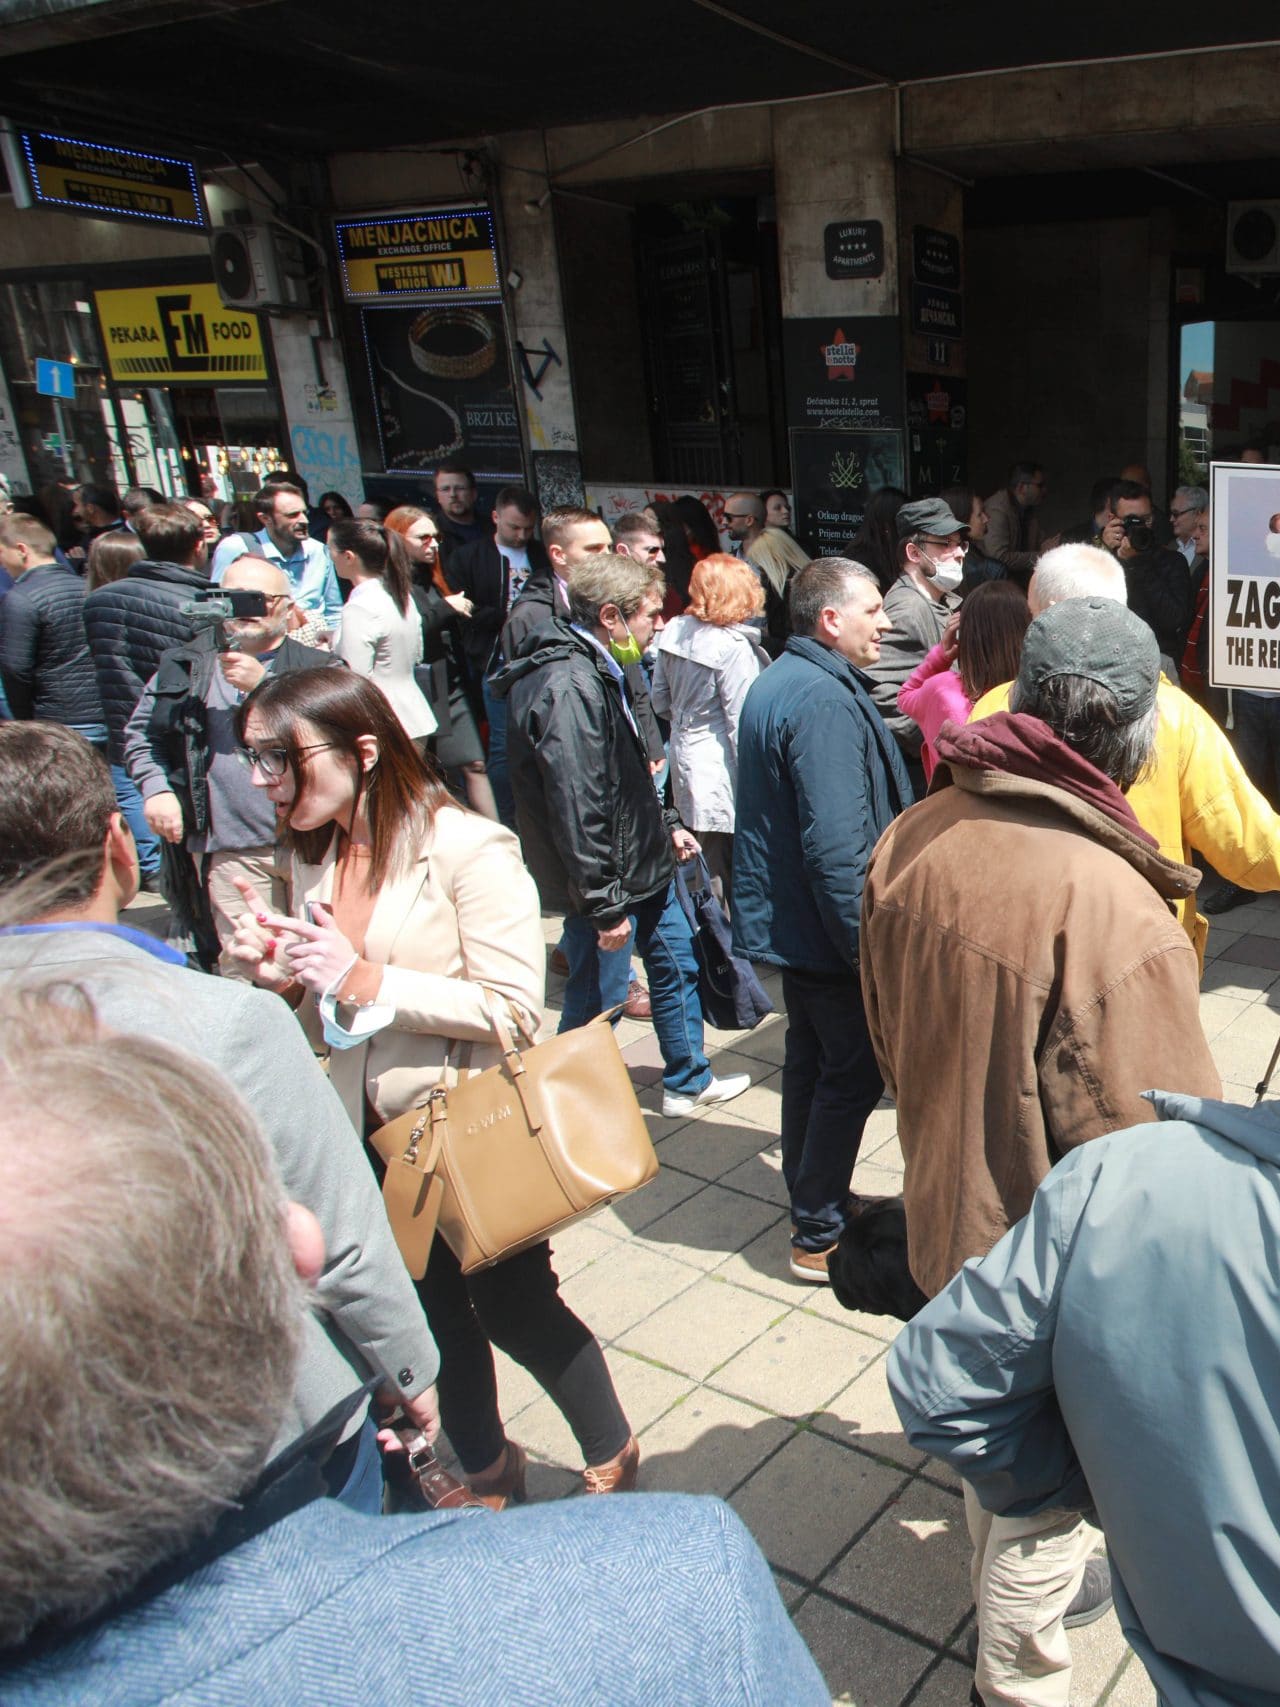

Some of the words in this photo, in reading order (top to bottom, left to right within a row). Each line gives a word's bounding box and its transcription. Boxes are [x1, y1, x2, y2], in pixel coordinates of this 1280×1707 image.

[839, 227, 867, 239] LUXURY
[377, 245, 421, 256] EXCHANGE
[423, 242, 452, 252] OFFICE
[832, 252, 876, 266] APARTMENTS
[378, 265, 428, 280] WESTERN
[395, 276, 429, 290] UNION
[109, 326, 160, 344] PEKARA
[212, 321, 252, 341] FOOD
[466, 411, 493, 427] BRZI
[817, 510, 840, 523] Otkup
[818, 528, 841, 540] Prijem
[1226, 636, 1254, 667] THE
